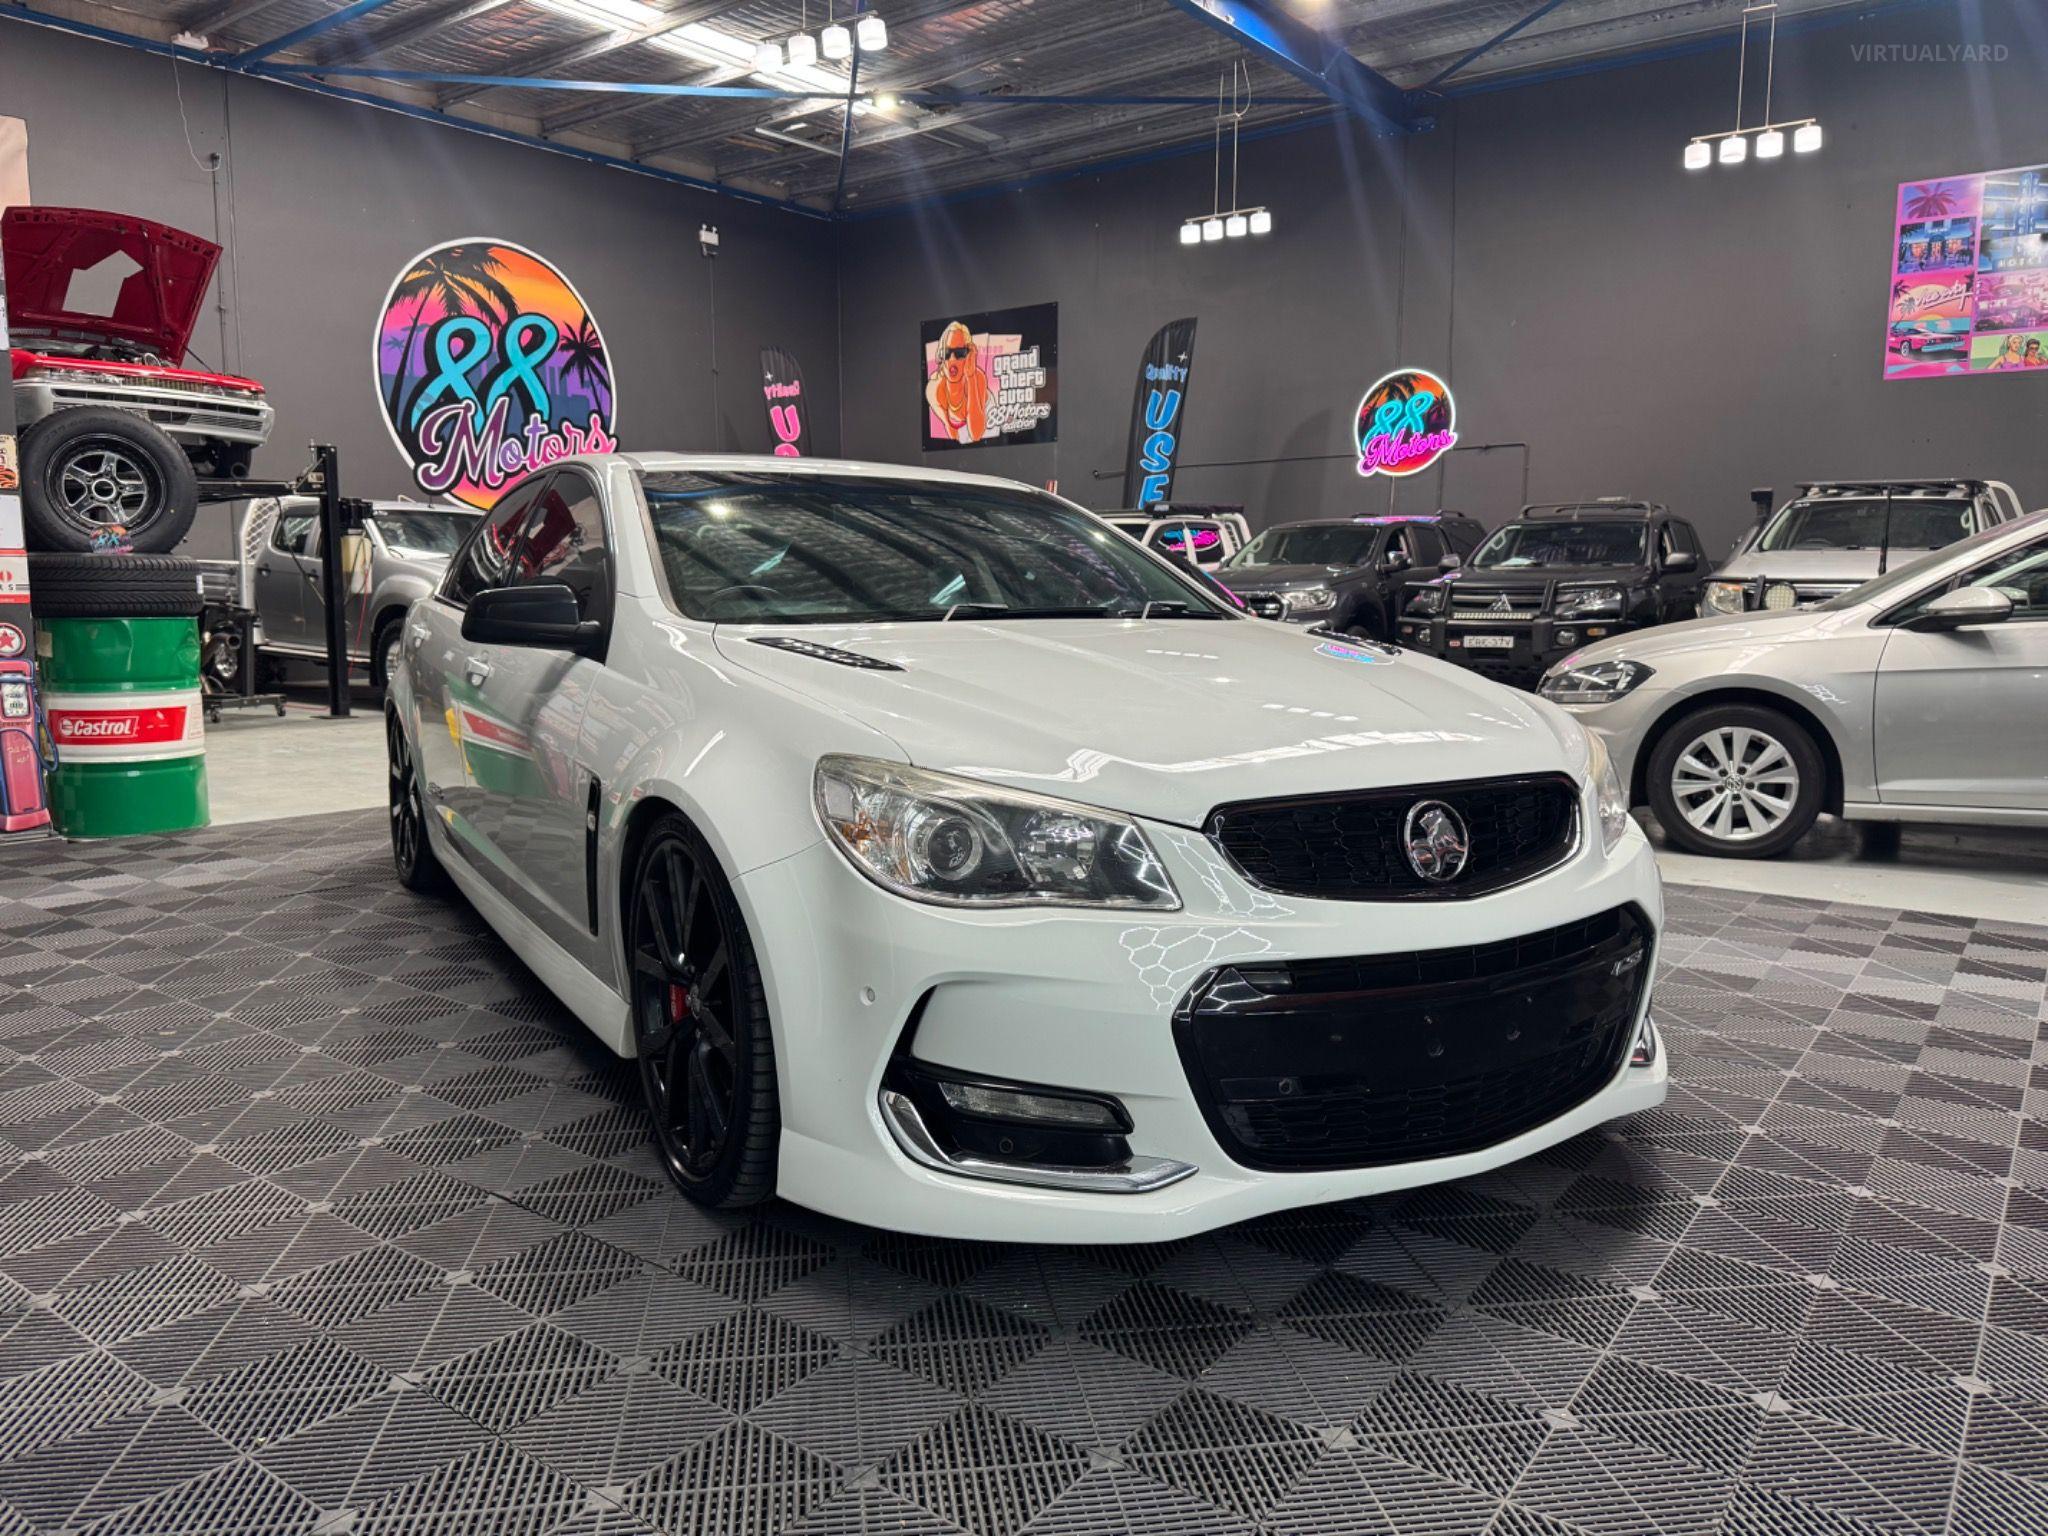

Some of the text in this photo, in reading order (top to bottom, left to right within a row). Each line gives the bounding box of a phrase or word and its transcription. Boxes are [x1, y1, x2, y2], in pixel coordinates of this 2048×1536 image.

[411, 313, 558, 432] 88
[416, 397, 617, 490] Motors
[1362, 391, 1435, 451] 88
[1360, 428, 1455, 475] Motors
[73, 718, 132, 736] Castrol
